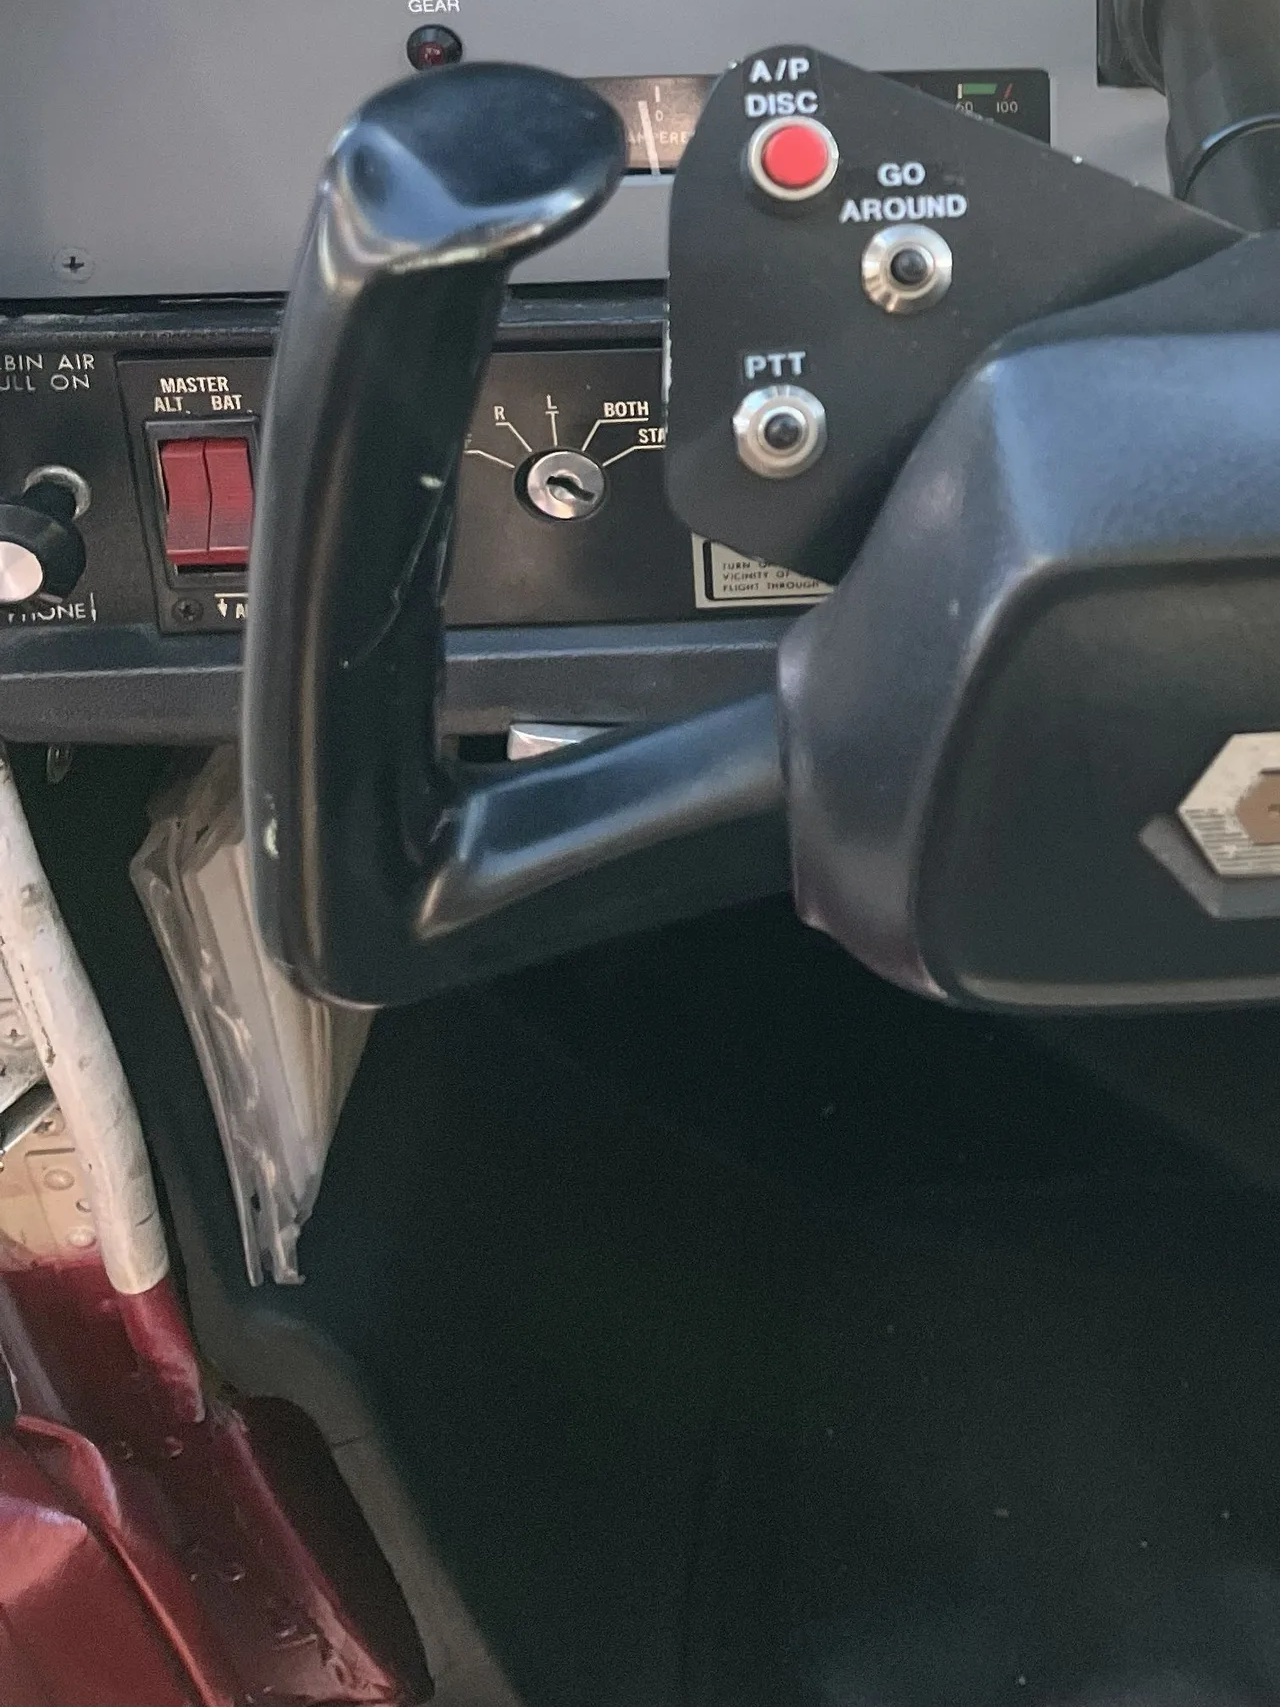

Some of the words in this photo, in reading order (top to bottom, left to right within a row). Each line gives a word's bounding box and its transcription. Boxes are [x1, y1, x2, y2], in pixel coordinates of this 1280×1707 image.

[749, 57, 810, 84] A/P
[745, 91, 818, 118] DISC
[878, 162, 925, 187] GO
[839, 194, 967, 223] AROUND
[58, 354, 94, 371] AIR
[745, 352, 806, 379] PTT
[51, 375, 90, 390] ON
[160, 376, 230, 393] MASTER
[604, 401, 649, 417] BOTH
